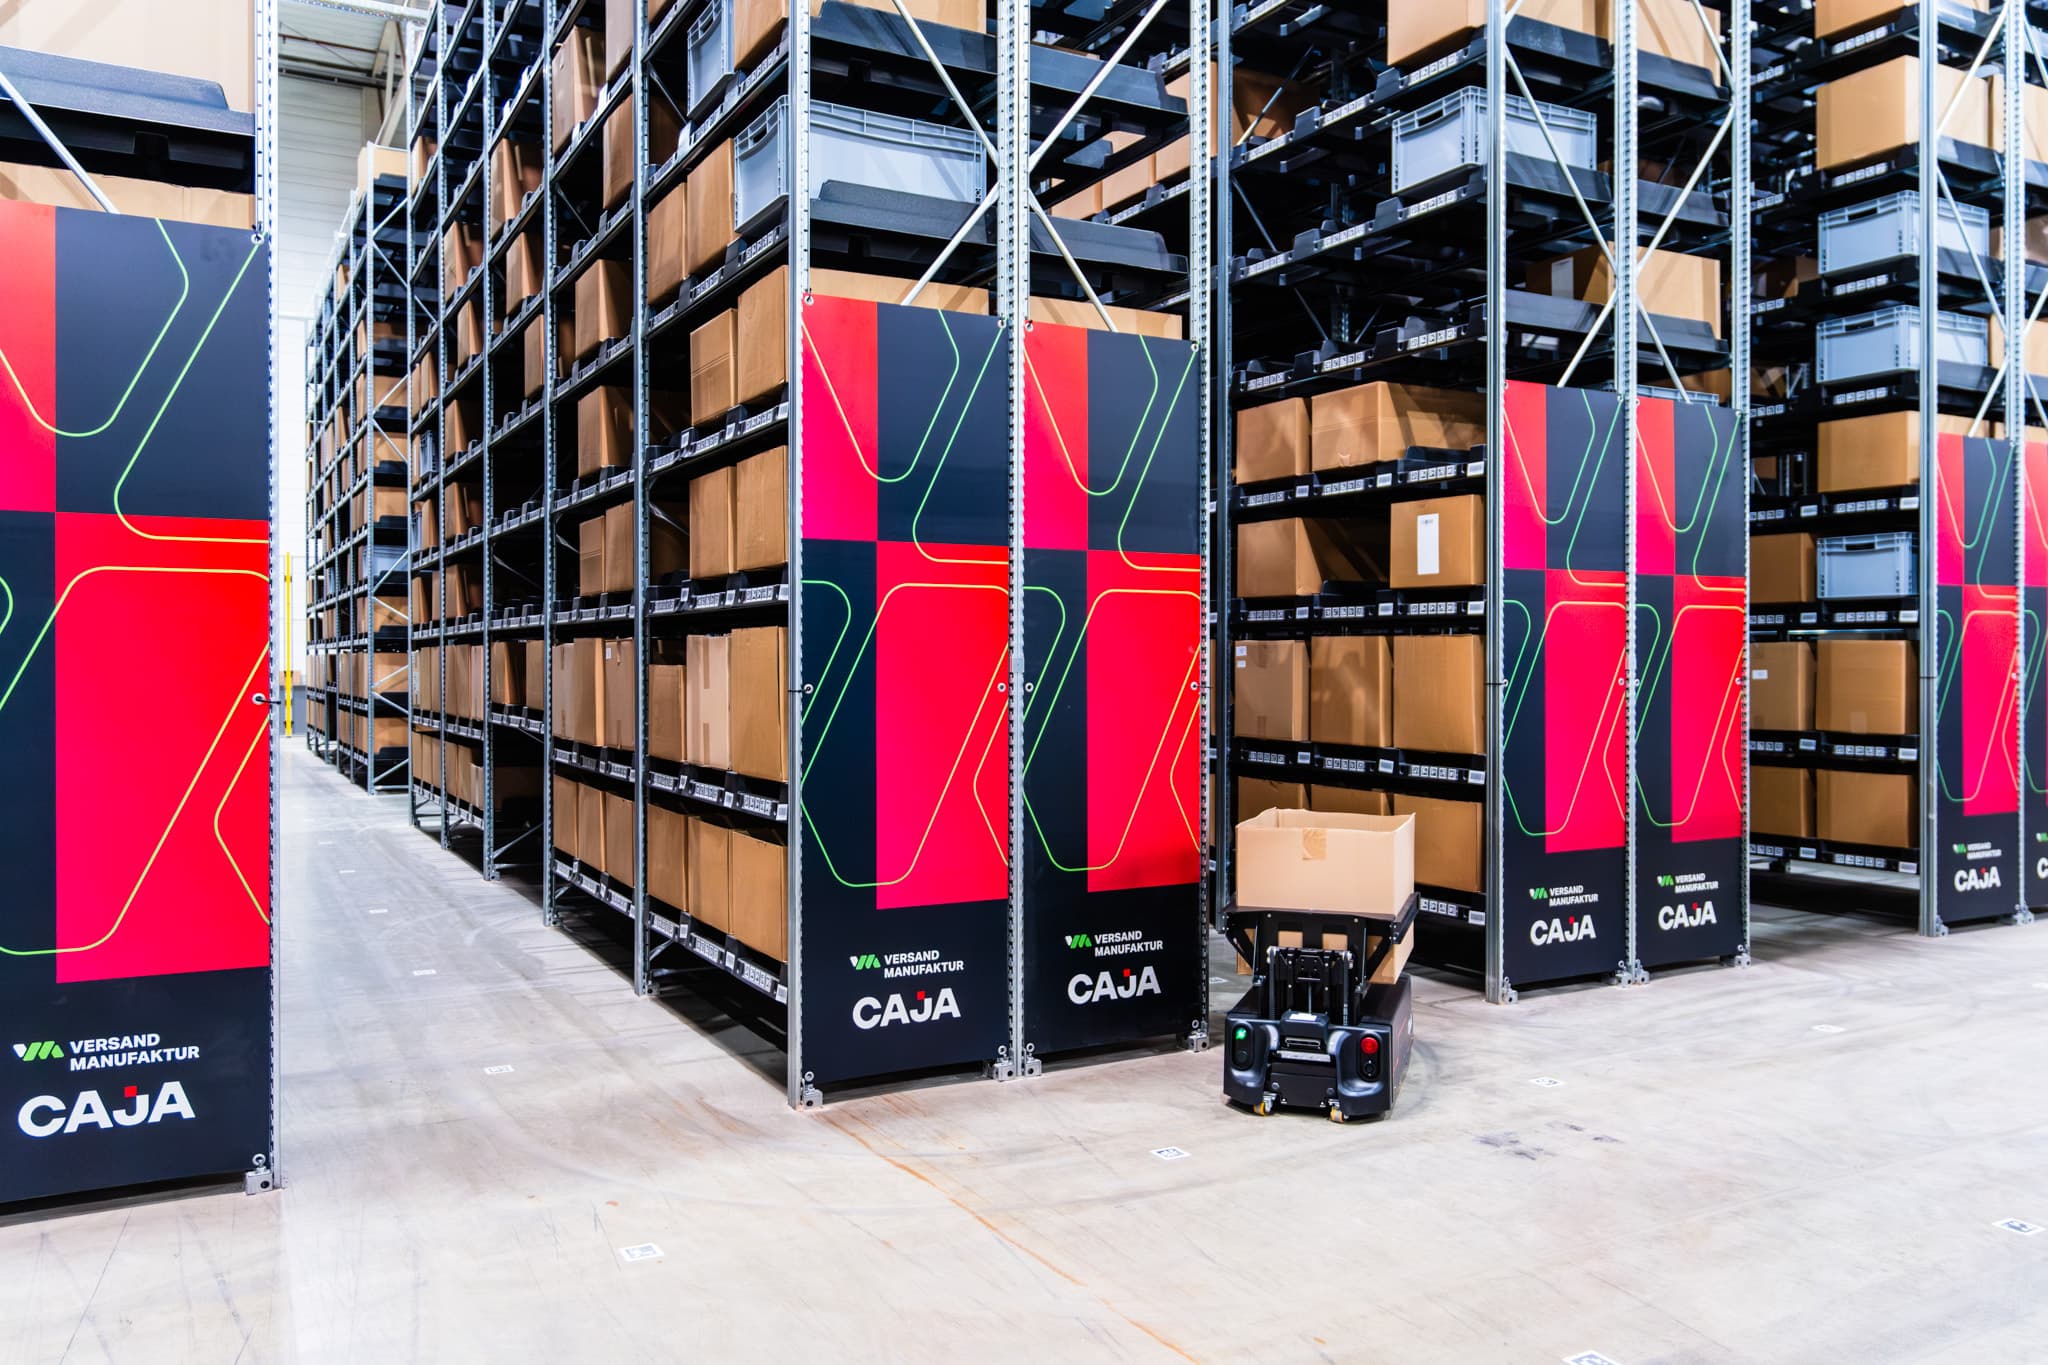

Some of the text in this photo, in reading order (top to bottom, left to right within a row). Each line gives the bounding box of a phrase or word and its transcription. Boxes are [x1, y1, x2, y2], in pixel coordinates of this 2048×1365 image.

[1658, 900, 1717, 931] CAJA
[1094, 930, 1143, 945] VERSAND
[1529, 914, 1597, 946] CAJA
[883, 949, 940, 966] VERSAND
[1094, 940, 1163, 957] MANUFAKTUR
[883, 960, 965, 979] MANUFAKTUR
[1067, 965, 1162, 1005] CAJA
[852, 987, 962, 1030] CAJA
[69, 1033, 161, 1054] VERSAND
[69, 1044, 201, 1072] MANUFAKTUR
[18, 1080, 196, 1138] CAJA
